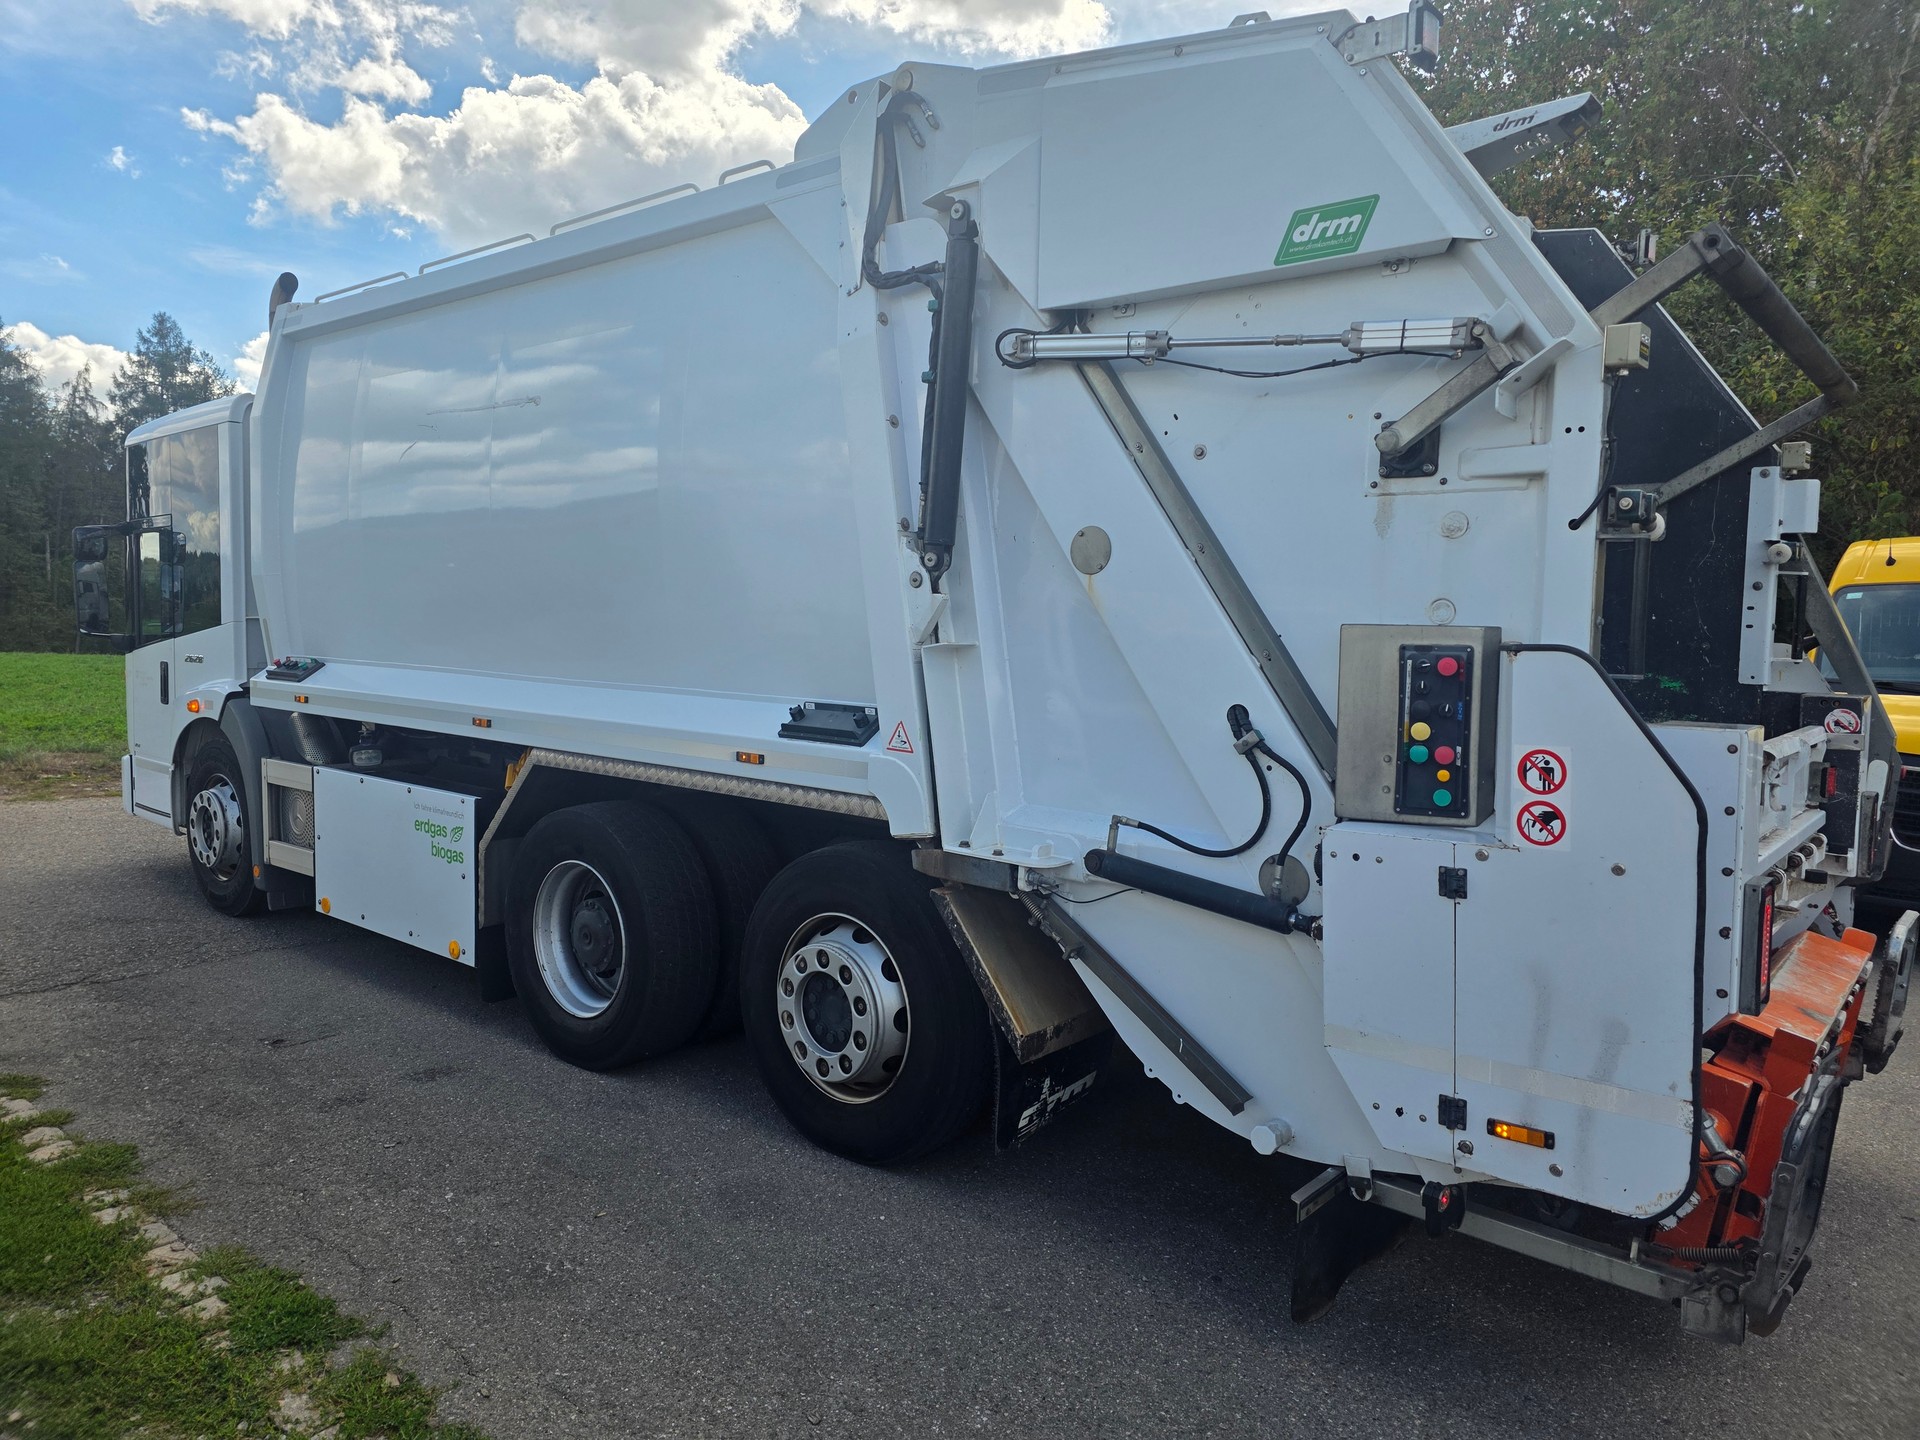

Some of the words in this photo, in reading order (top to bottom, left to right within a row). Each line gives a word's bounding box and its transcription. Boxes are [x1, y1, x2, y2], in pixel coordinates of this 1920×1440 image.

[1493, 116, 1535, 132] drm
[1292, 212, 1362, 243] drm
[414, 818, 448, 839] erdgas
[431, 840, 464, 864] biogas
